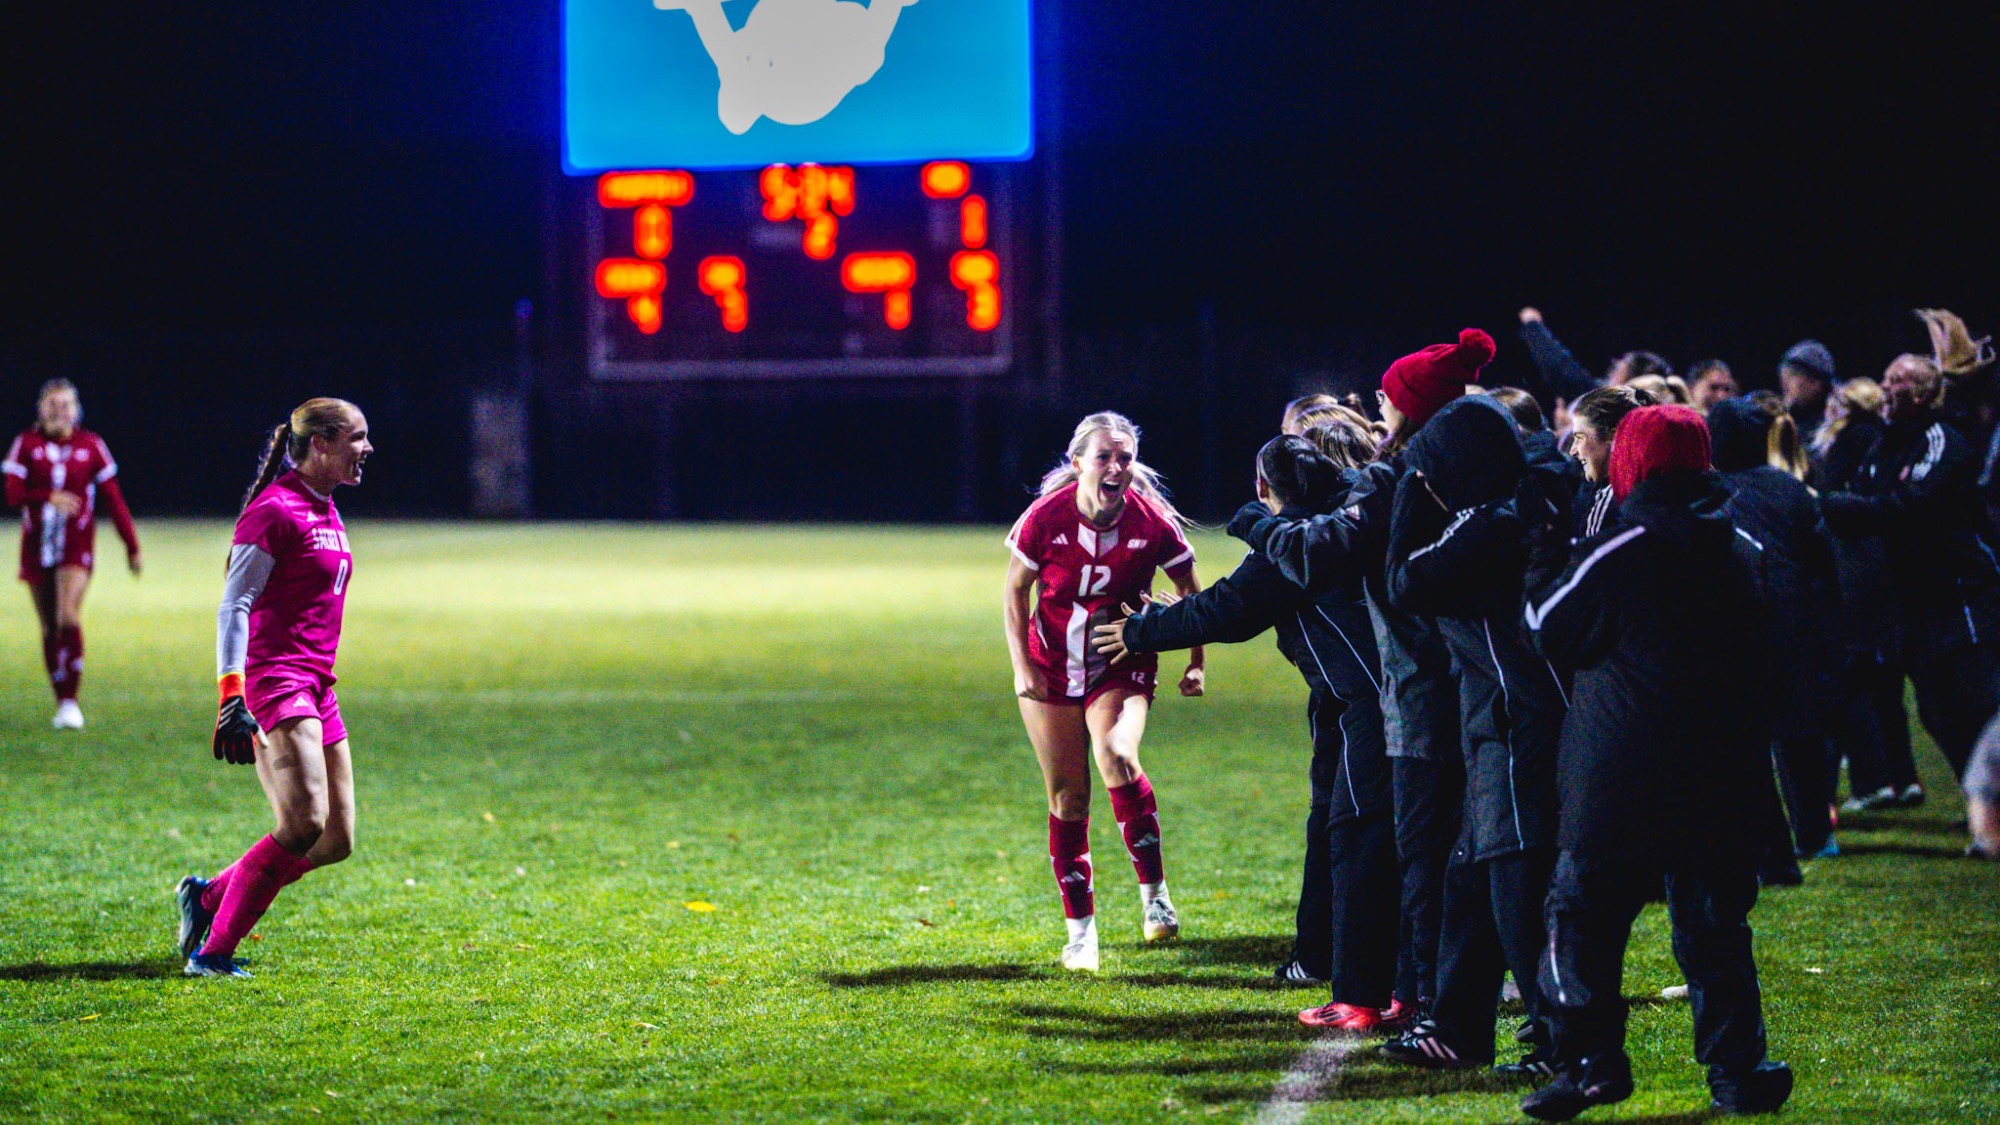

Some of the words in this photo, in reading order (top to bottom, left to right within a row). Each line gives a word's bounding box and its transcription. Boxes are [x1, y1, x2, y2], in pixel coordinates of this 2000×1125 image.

[333, 558, 348, 596] 0
[1078, 564, 1111, 597] 12
[1131, 671, 1145, 685] 12
